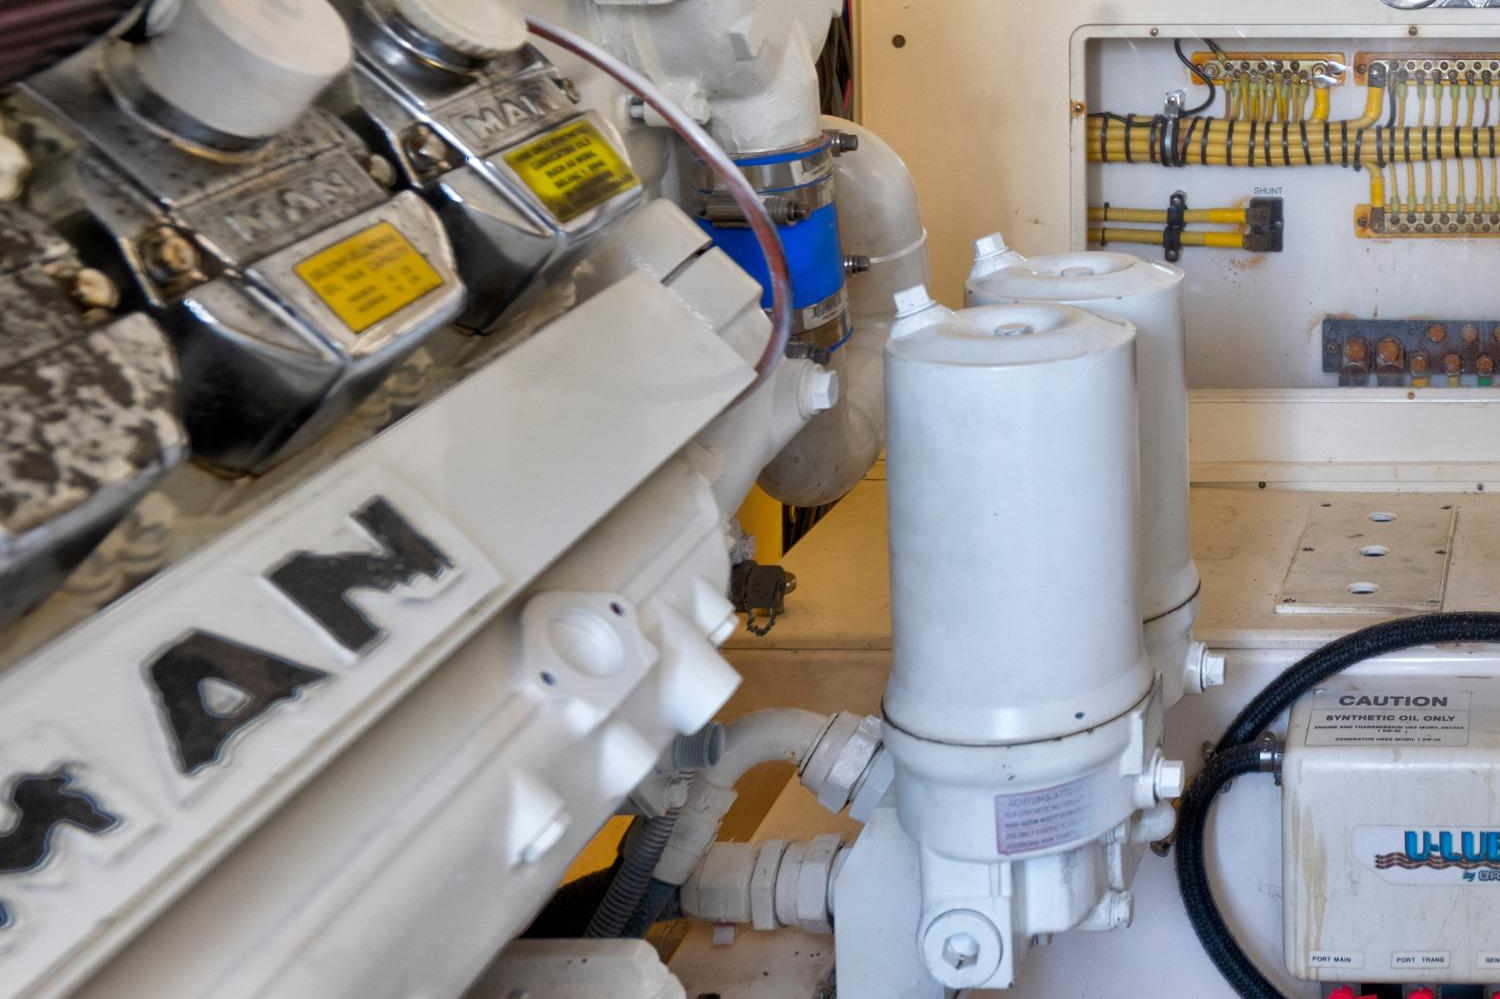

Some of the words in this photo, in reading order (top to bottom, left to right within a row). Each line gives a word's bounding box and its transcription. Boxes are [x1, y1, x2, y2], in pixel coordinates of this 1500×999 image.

[462, 95, 560, 140] MAN
[1254, 186, 1283, 195] SHUNT
[223, 171, 357, 242] MAN
[1339, 695, 1448, 707] CAUTION
[1462, 870, 1476, 882] by
